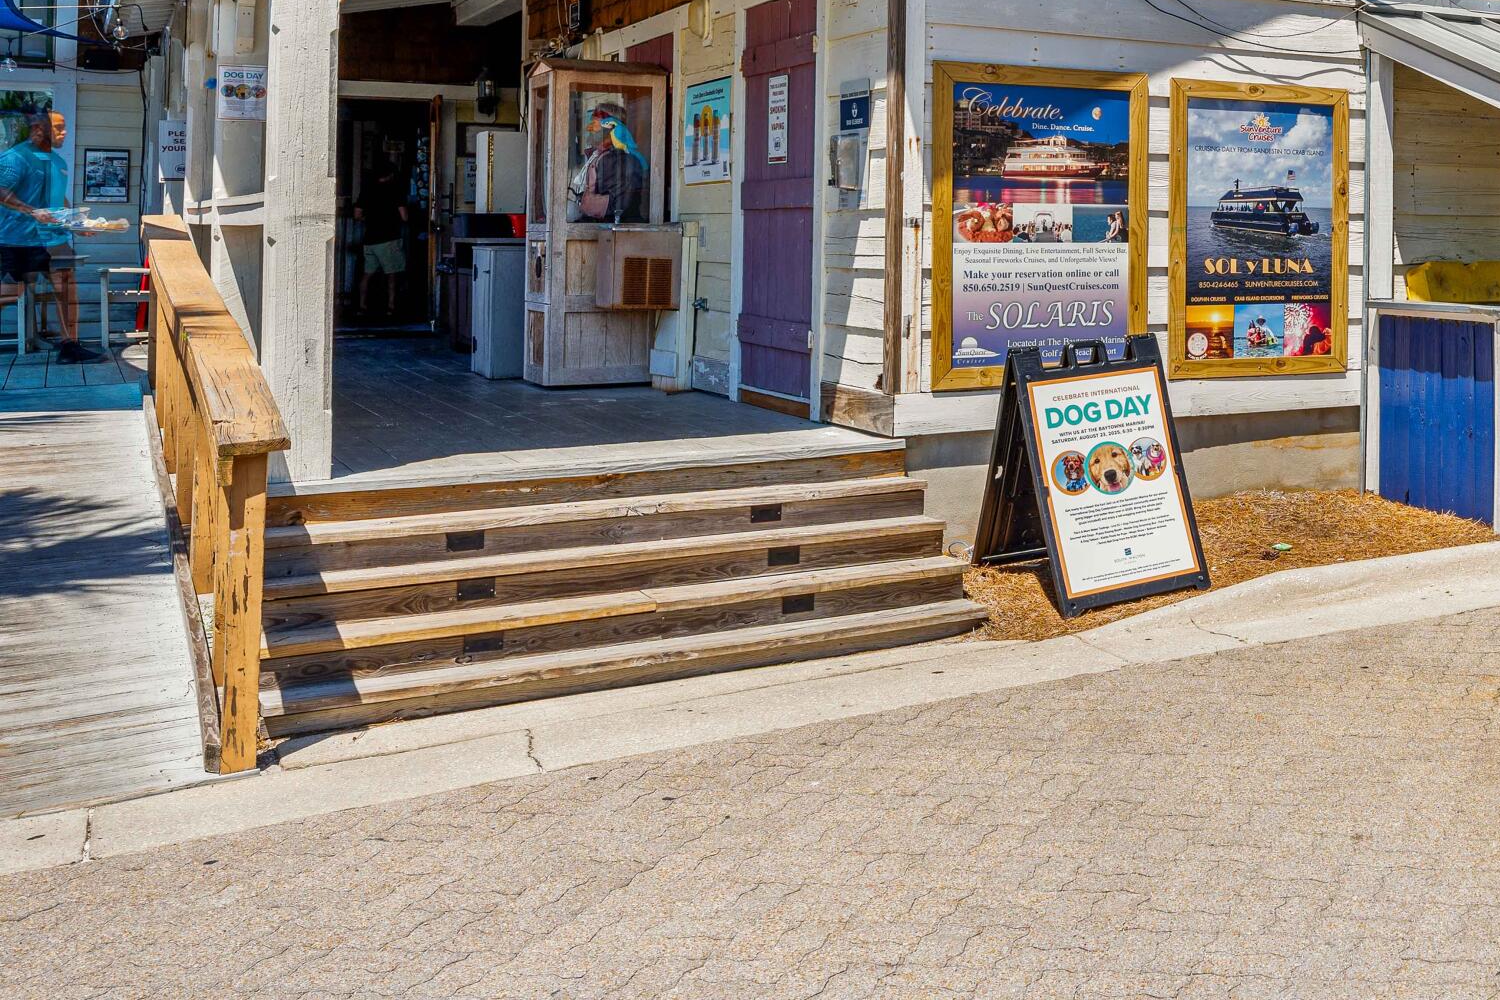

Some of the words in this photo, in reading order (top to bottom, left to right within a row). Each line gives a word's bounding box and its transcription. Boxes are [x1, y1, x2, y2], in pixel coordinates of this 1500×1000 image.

[224, 71, 244, 79] DOG
[246, 71, 264, 80] DAY
[963, 87, 1064, 120] Celebrate.
[1032, 122, 1049, 130] Dine.
[1050, 123, 1072, 131] Dance.
[1073, 124, 1095, 132] Cruise.
[1240, 125, 1282, 134] SunVenture
[1248, 133, 1274, 141] Cruises
[954, 247, 972, 255] Enjoy
[973, 247, 1001, 255] Exquisite
[965, 256, 991, 264] Seasonal
[993, 256, 1023, 264] Fireworks
[1204, 258, 1242, 275] SOL
[1246, 260, 1259, 275] y
[1262, 258, 1314, 274] LUNA
[963, 270, 989, 279] Make
[991, 271, 1013, 281] your
[1014, 269, 1063, 279] reservation
[1065, 269, 1092, 278] online
[1093, 270, 1103, 278] or
[1104, 269, 1120, 278] call
[962, 283, 1020, 293] 850.650.2519
[1027, 282, 1120, 292] SunQuestCruises.com
[1198, 281, 1239, 289] 850-424-6465
[1245, 280, 1318, 288] SUNVENTURECRUISES.COM
[966, 311, 984, 321] The
[985, 299, 1115, 330] SOLARIS
[1007, 339, 1037, 347] Located
[1038, 339, 1046, 347] at
[1047, 338, 1063, 346] The
[1101, 336, 1125, 344] Marina
[1041, 349, 1057, 358] Golf
[1052, 390, 1089, 402] CELEBRATE
[1090, 385, 1140, 397] INTERNATIONAL
[1045, 401, 1102, 429] DOG
[1104, 394, 1152, 420] DAY
[1098, 423, 1124, 431] BAYTOWNE
[1051, 436, 1078, 445] SATURDAY,
[1079, 433, 1099, 441] AUGUST
